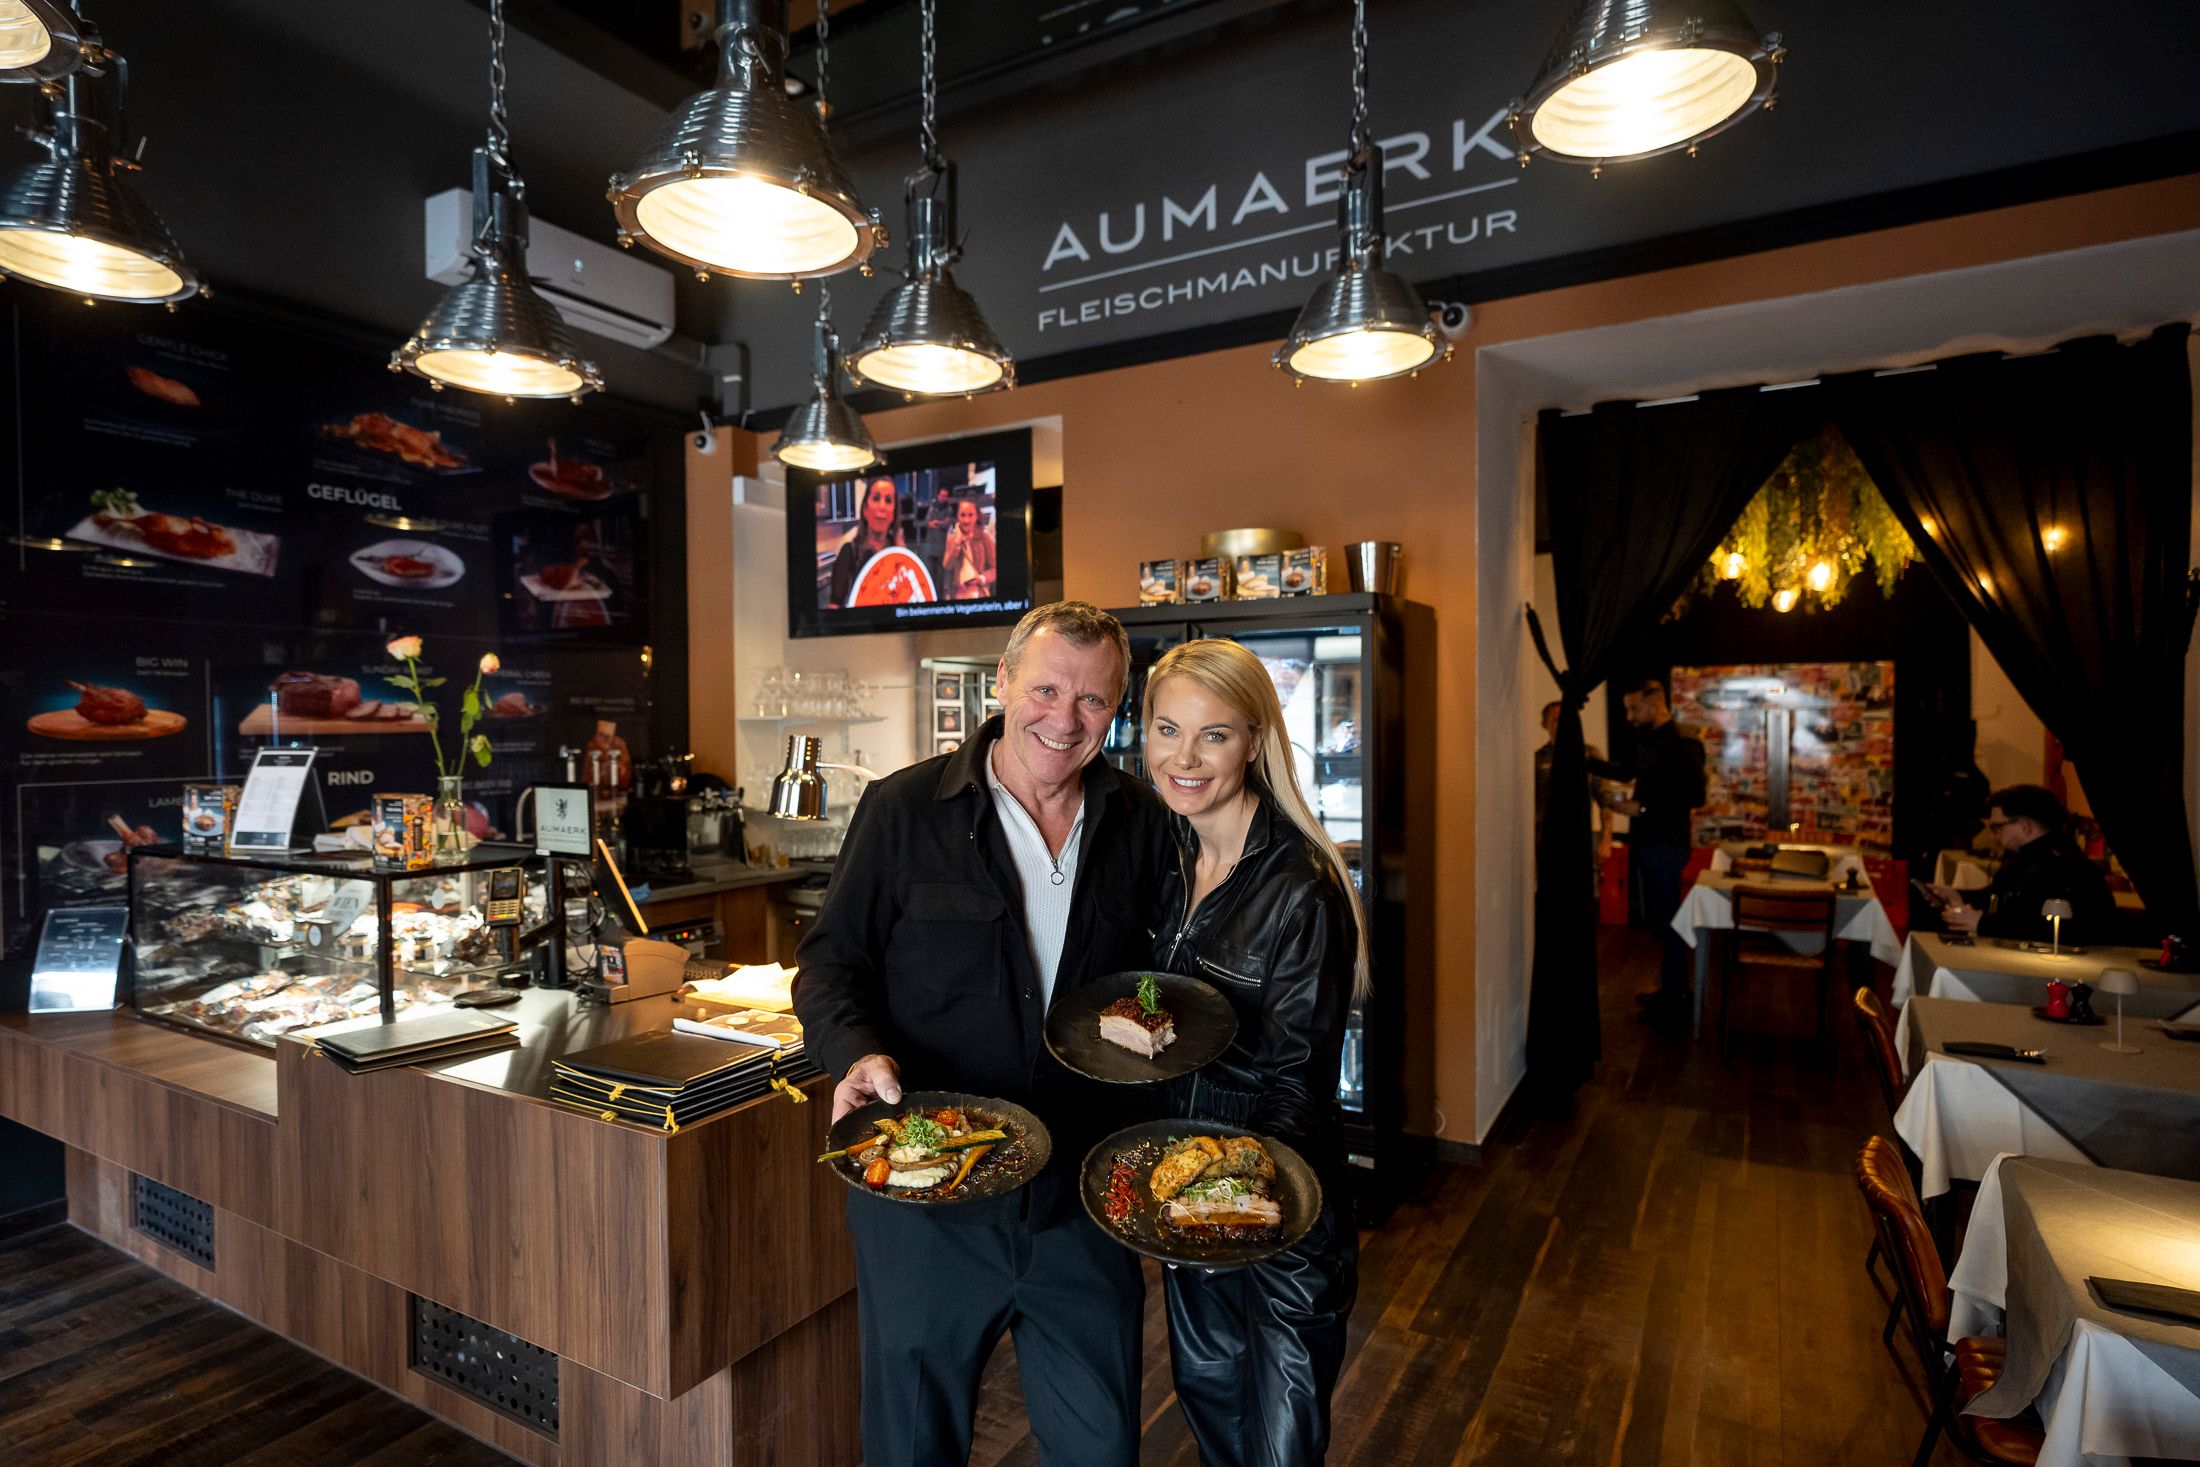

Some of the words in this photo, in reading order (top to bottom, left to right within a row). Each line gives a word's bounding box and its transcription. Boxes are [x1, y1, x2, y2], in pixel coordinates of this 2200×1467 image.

[1042, 107, 1516, 271] AUMAERK
[1038, 209, 1518, 332] FLEISCHMANUFKTUR
[306, 482, 403, 512] GEFLÜGEL
[135, 656, 160, 668] BIG
[160, 657, 190, 668] WIN
[327, 769, 376, 787] RIND
